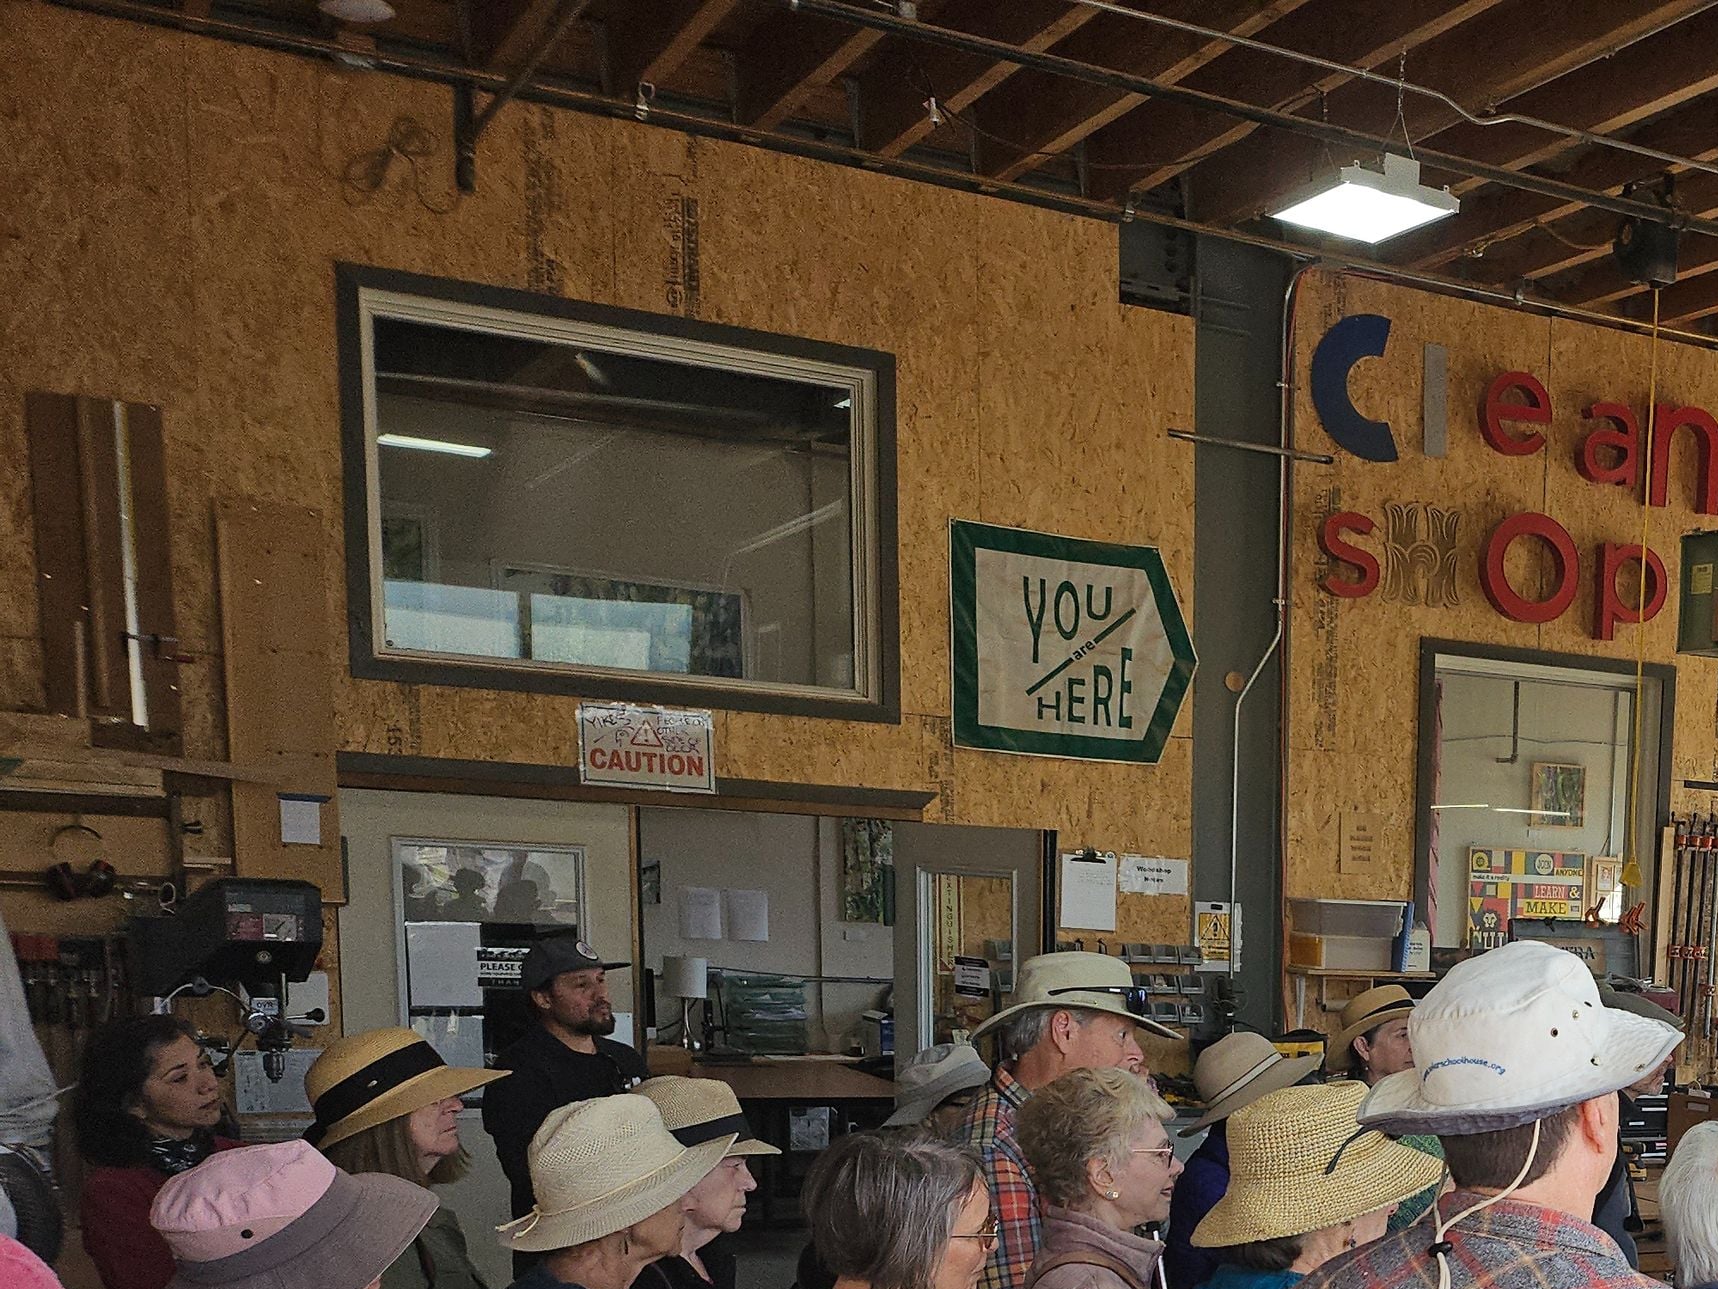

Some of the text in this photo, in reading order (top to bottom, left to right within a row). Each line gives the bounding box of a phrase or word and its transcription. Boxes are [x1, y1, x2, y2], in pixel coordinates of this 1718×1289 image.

[1023, 576, 1113, 663] YOU
[1072, 640, 1096, 661] are
[1037, 647, 1133, 729] HERE
[590, 747, 704, 777] CAUTION
[1534, 884, 1566, 899] LEARN
[1525, 901, 1568, 915] MAKE
[480, 962, 516, 971] PLEASE
